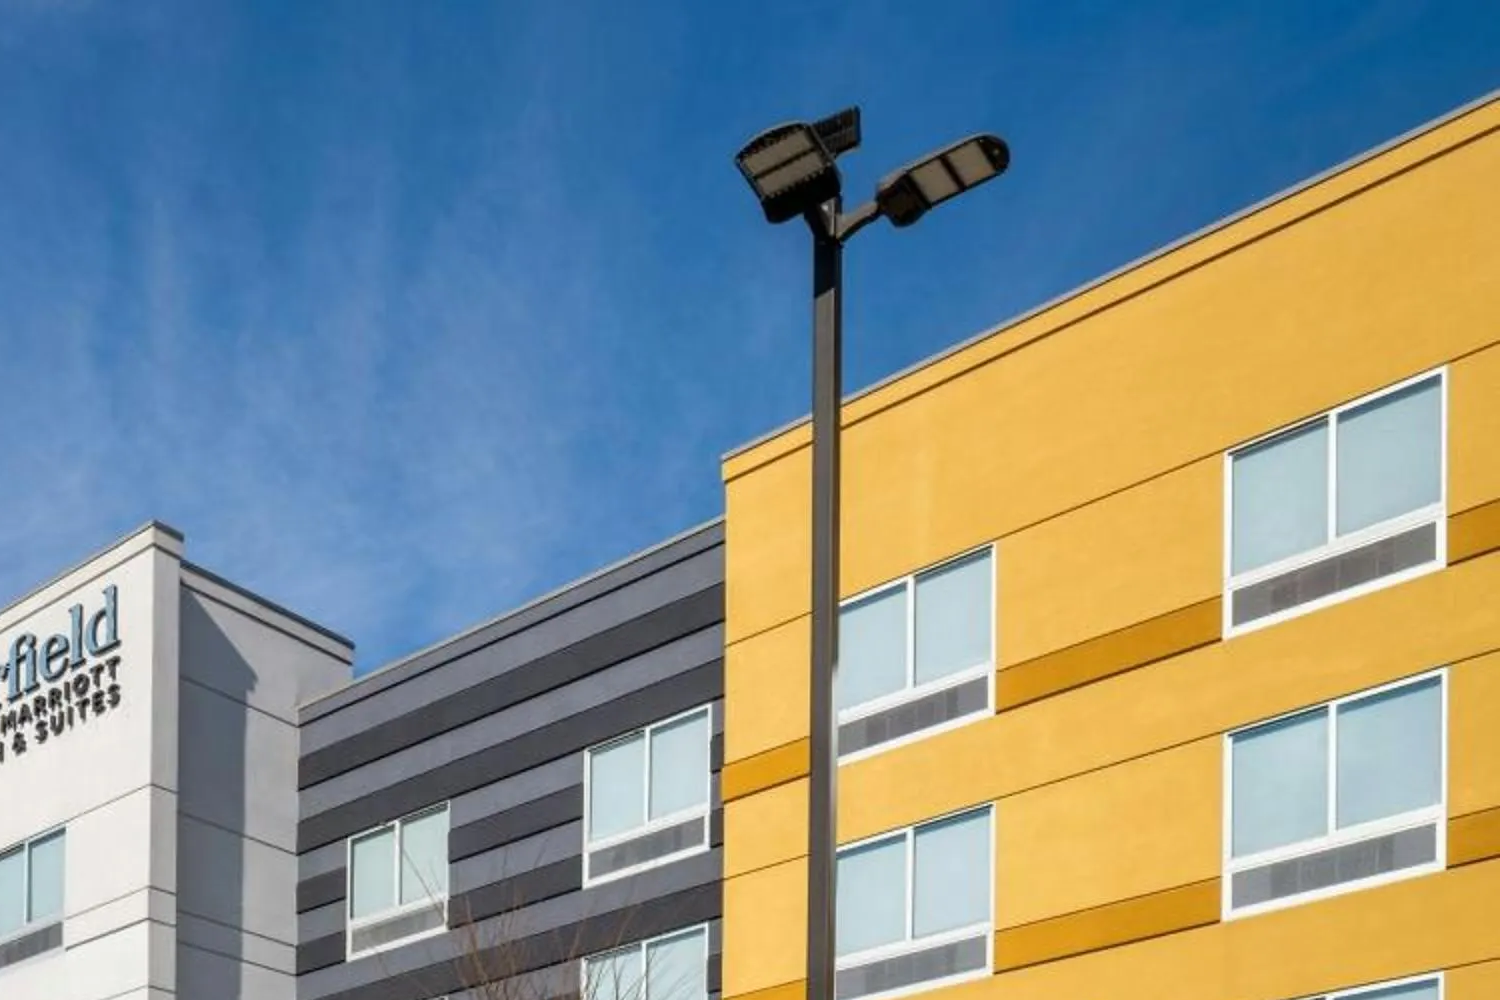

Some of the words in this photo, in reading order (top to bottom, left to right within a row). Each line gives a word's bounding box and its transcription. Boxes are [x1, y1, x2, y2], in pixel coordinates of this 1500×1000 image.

[0, 655, 122, 738] MARRIOTT
[11, 731, 27, 756] &
[35, 683, 122, 744] SUITES
